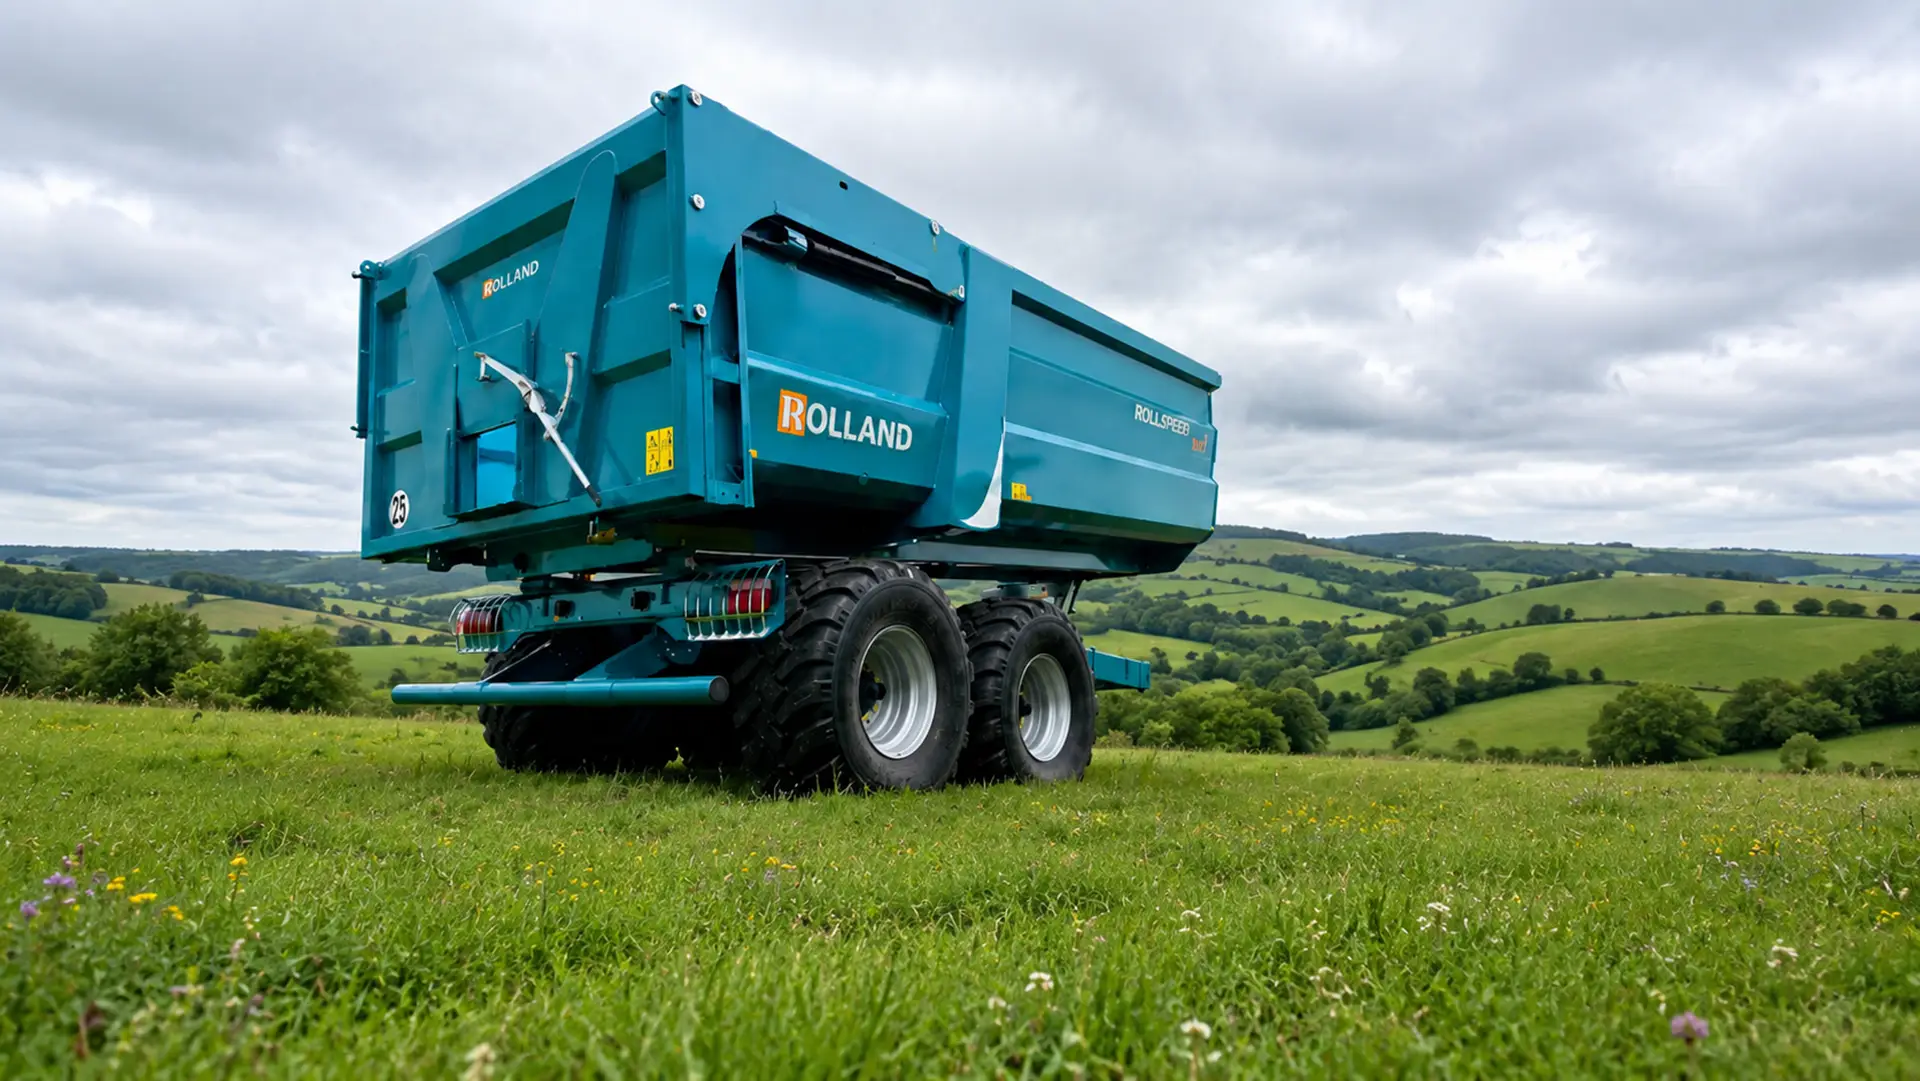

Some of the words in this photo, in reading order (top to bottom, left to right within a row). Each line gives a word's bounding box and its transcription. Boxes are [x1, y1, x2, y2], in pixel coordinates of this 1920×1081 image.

[482, 259, 539, 299] ROLLAND
[778, 389, 913, 451] ROLLAND
[392, 494, 406, 525] 25
